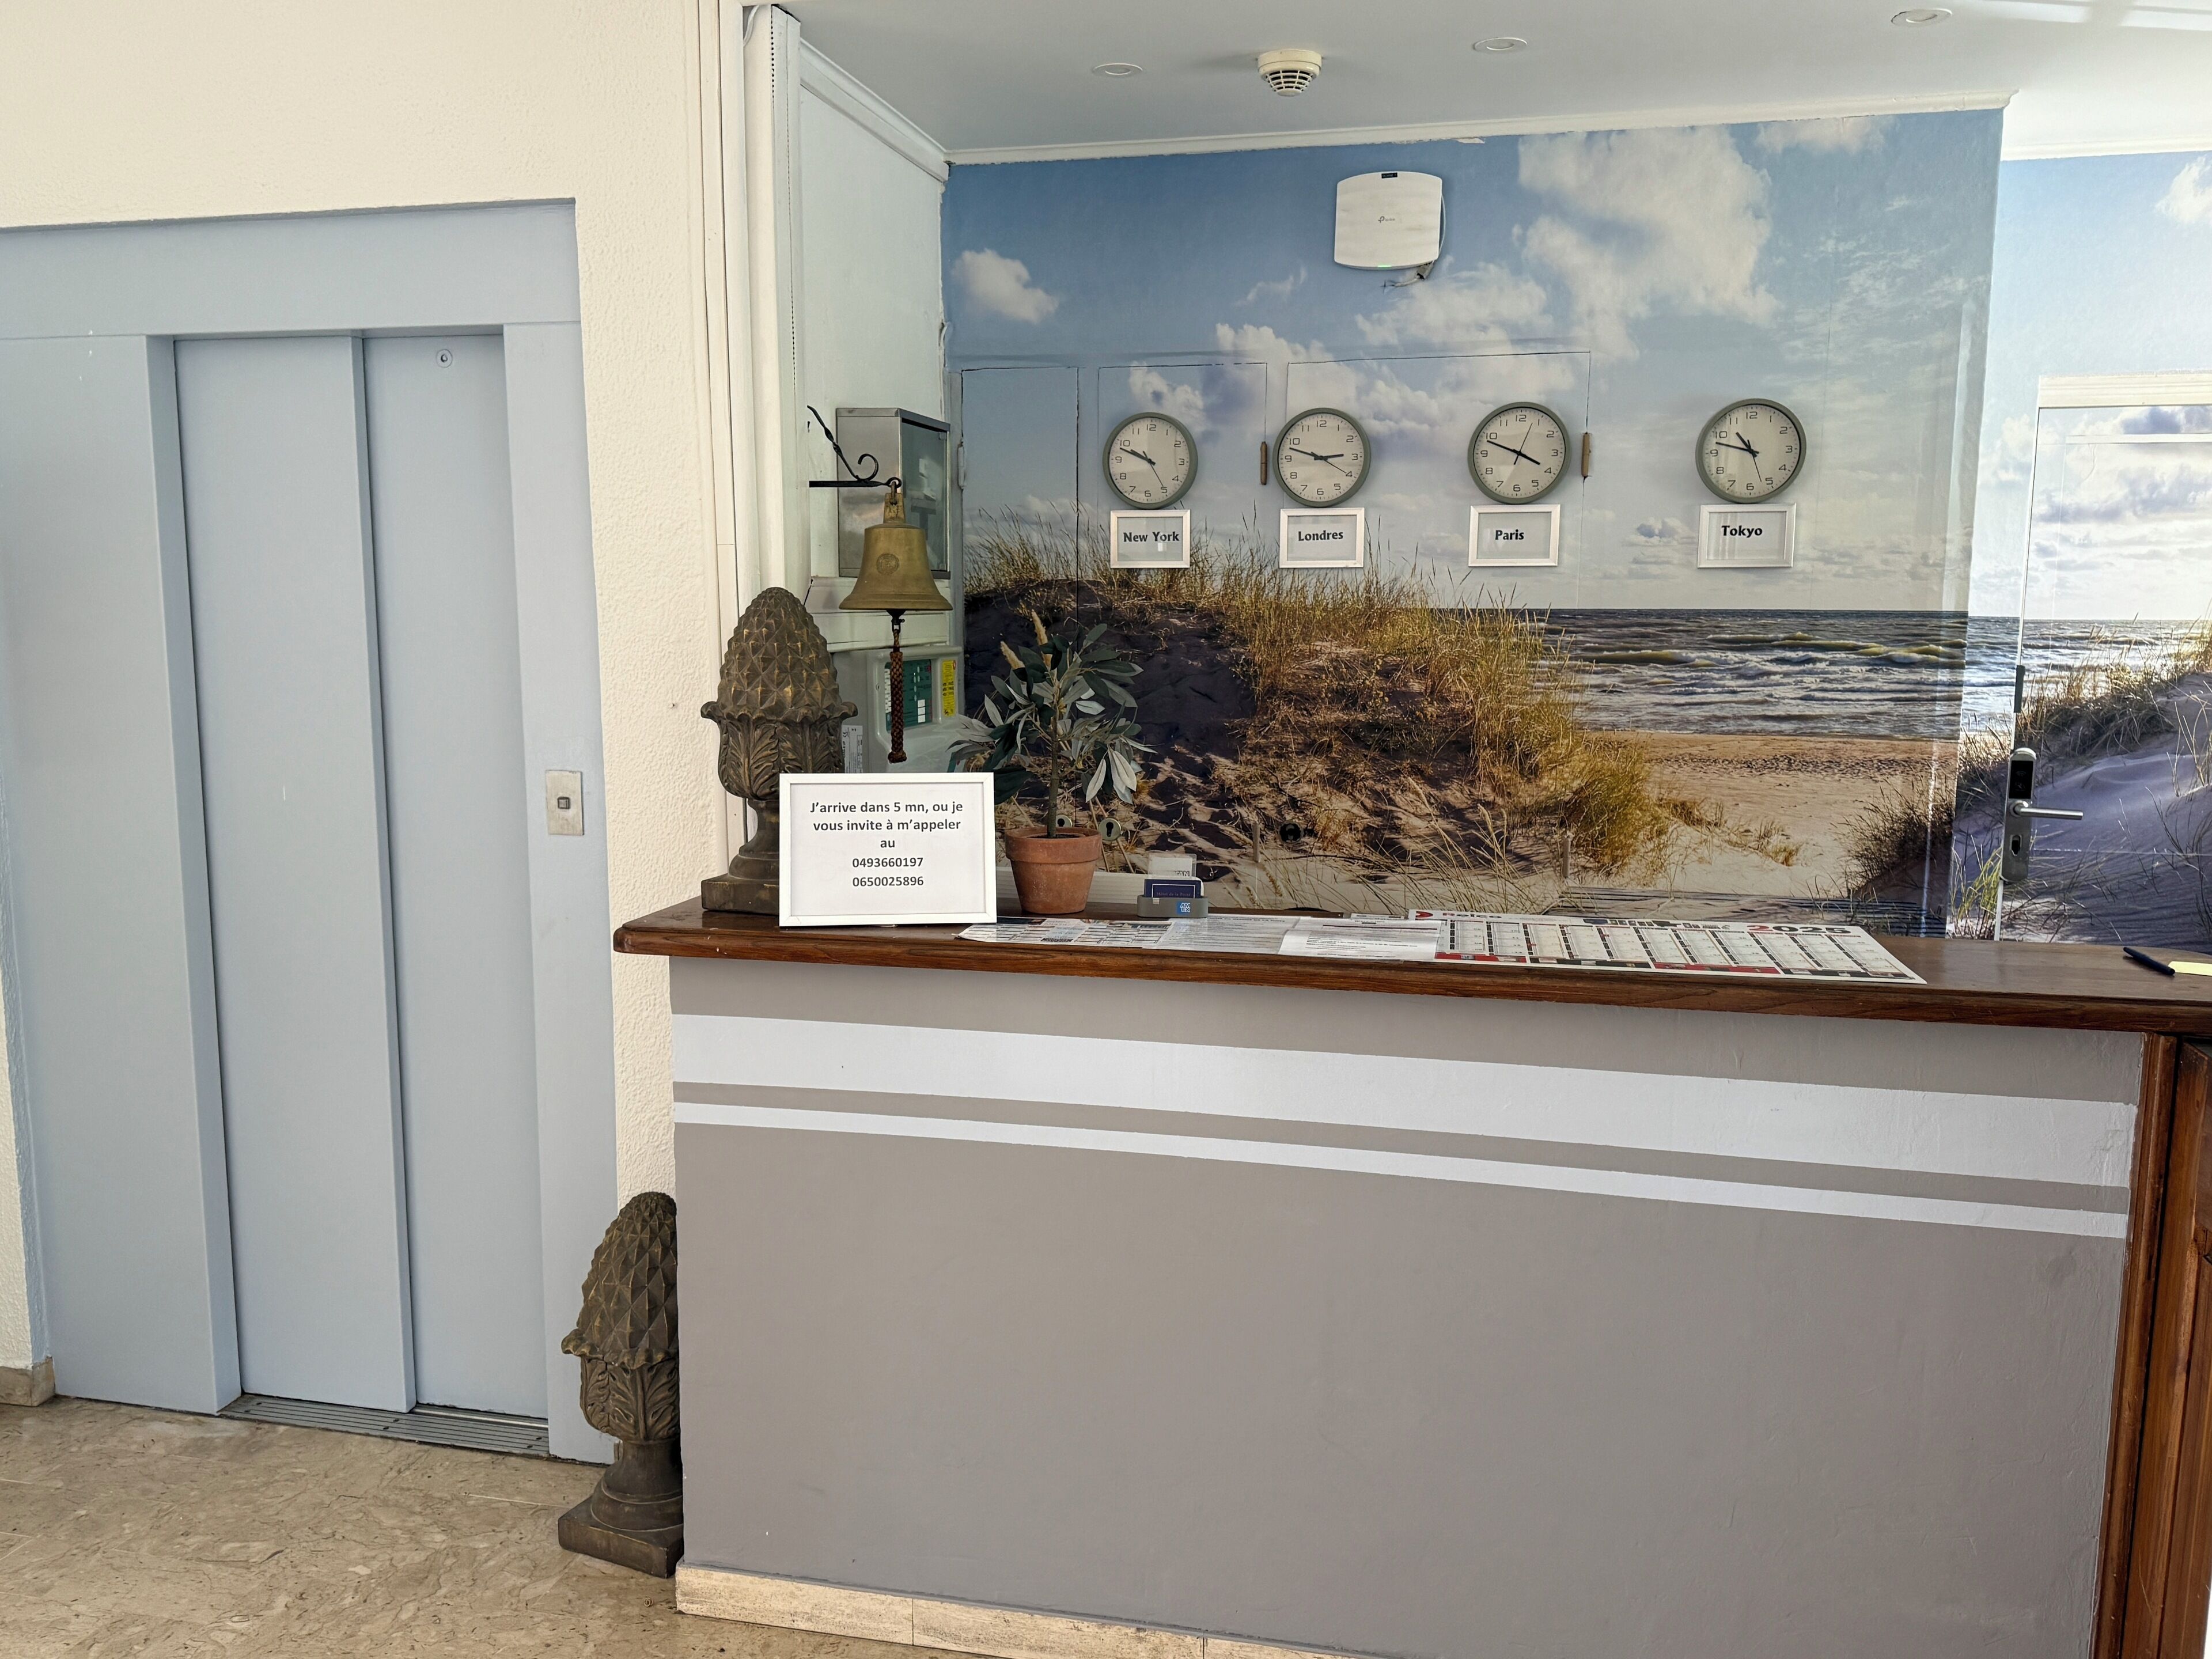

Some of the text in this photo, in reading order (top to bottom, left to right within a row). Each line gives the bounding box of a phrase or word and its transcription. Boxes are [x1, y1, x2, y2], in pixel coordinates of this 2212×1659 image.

[1299, 531, 1343, 541] Londres
[1495, 529, 1524, 540] Paris
[1722, 525, 1762, 537] Tokyo
[1124, 532, 1179, 541] New York
[810, 802, 856, 812] J’arrive
[861, 802, 889, 812] dans
[894, 802, 900, 812] 5
[906, 805, 928, 813] mn,
[952, 802, 963, 813] je
[847, 820, 882, 830] invite
[887, 820, 892, 830] à
[898, 819, 960, 832] m’appeler
[853, 858, 923, 867] 0493660197
[853, 877, 923, 887] 0650025896
[1747, 925, 1851, 934] 2025
